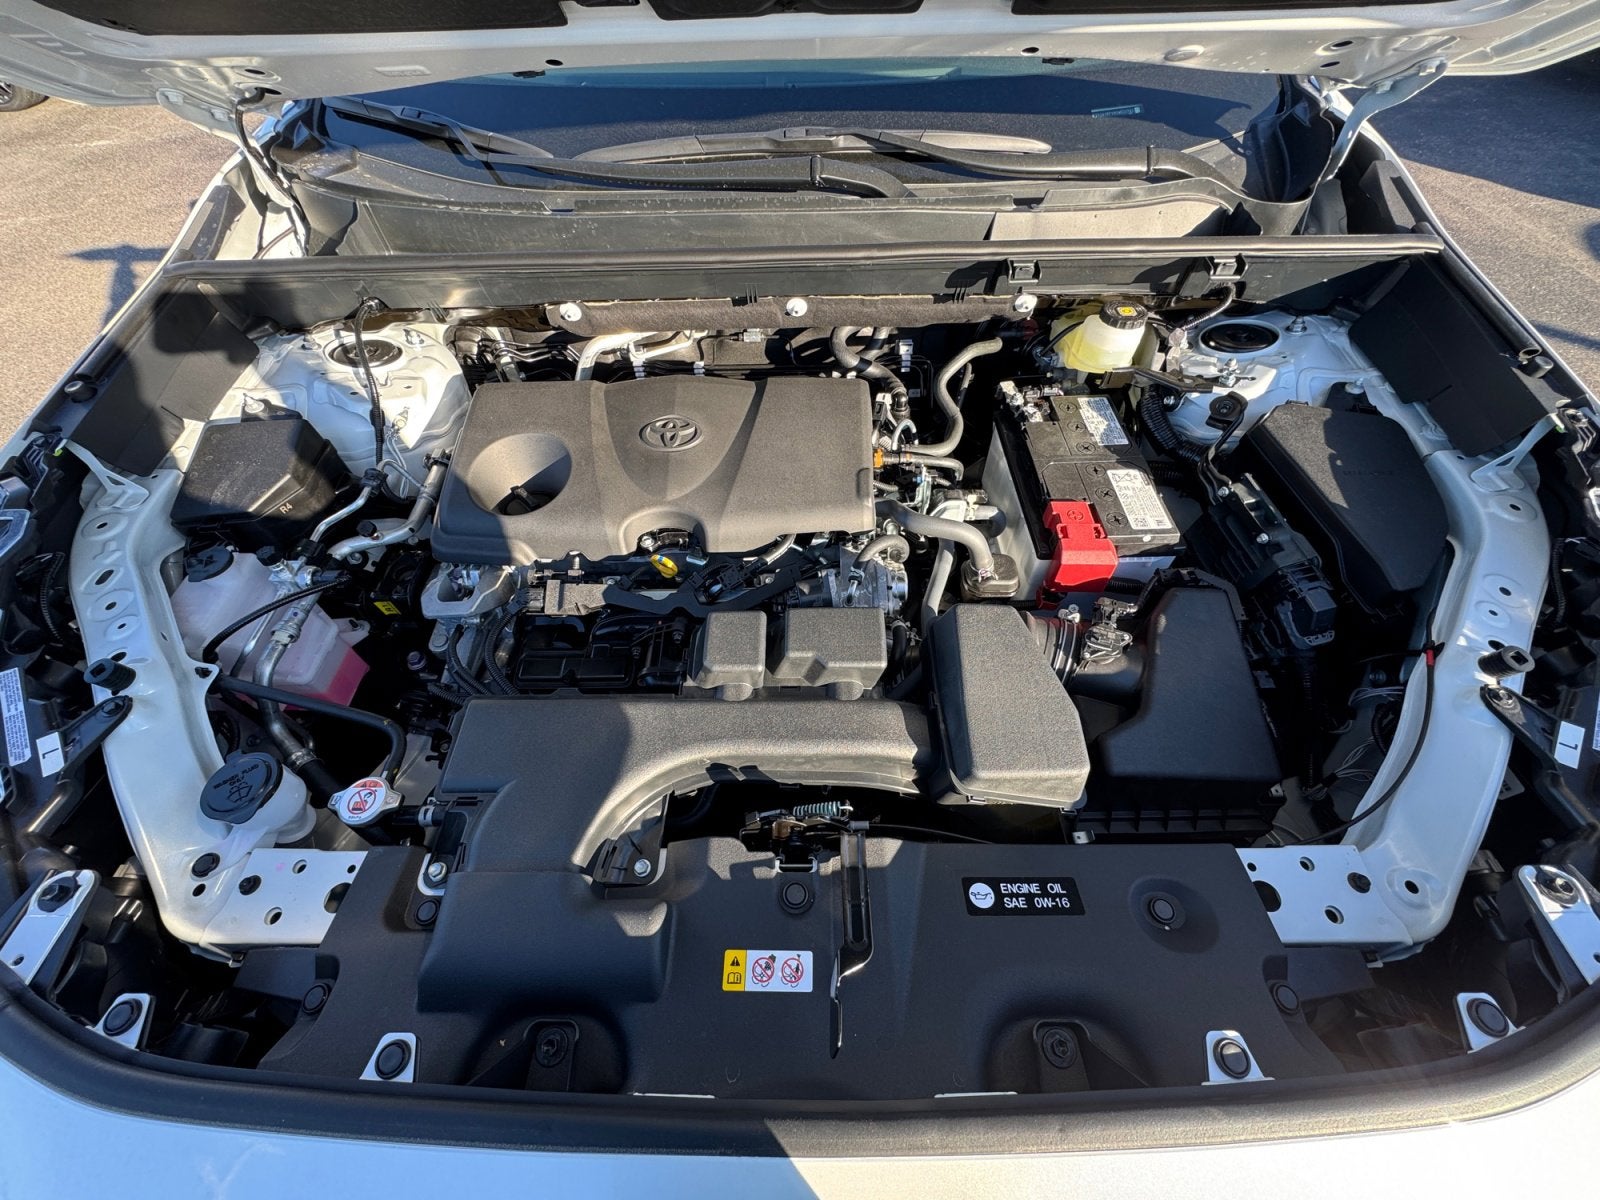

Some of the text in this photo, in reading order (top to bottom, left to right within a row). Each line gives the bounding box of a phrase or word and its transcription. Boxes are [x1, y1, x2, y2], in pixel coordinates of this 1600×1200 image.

[280, 502, 293, 514] R4
[1000, 883, 1067, 894] ENGINE OIL
[1004, 897, 1071, 908] SAE 0W-16
